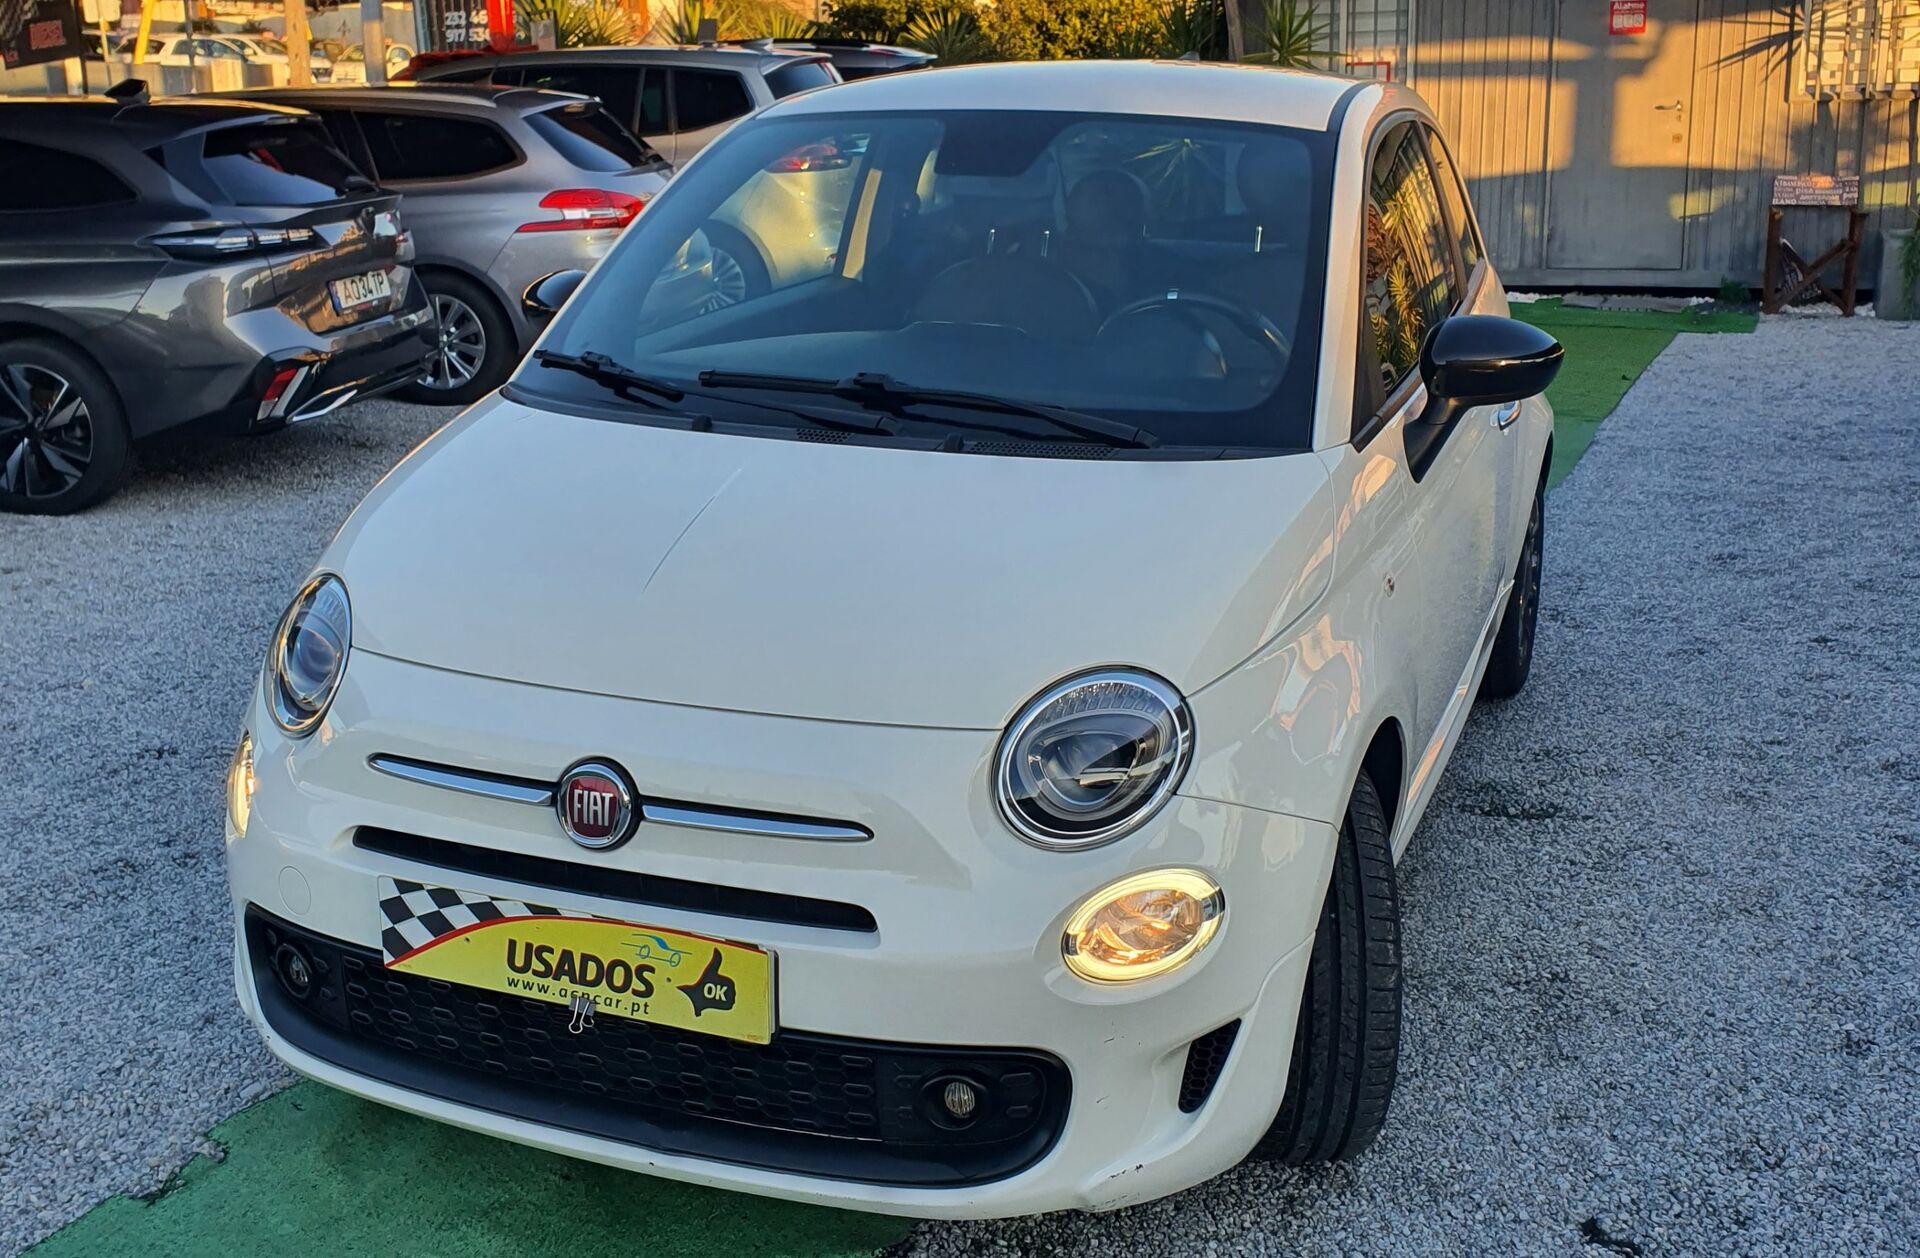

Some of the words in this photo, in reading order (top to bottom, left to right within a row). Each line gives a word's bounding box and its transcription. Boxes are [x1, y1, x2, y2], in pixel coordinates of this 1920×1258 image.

[445, 28, 466, 42] 917
[573, 788, 614, 827] FIAT
[506, 938, 656, 999] USADOS
[703, 982, 728, 1001] OK
